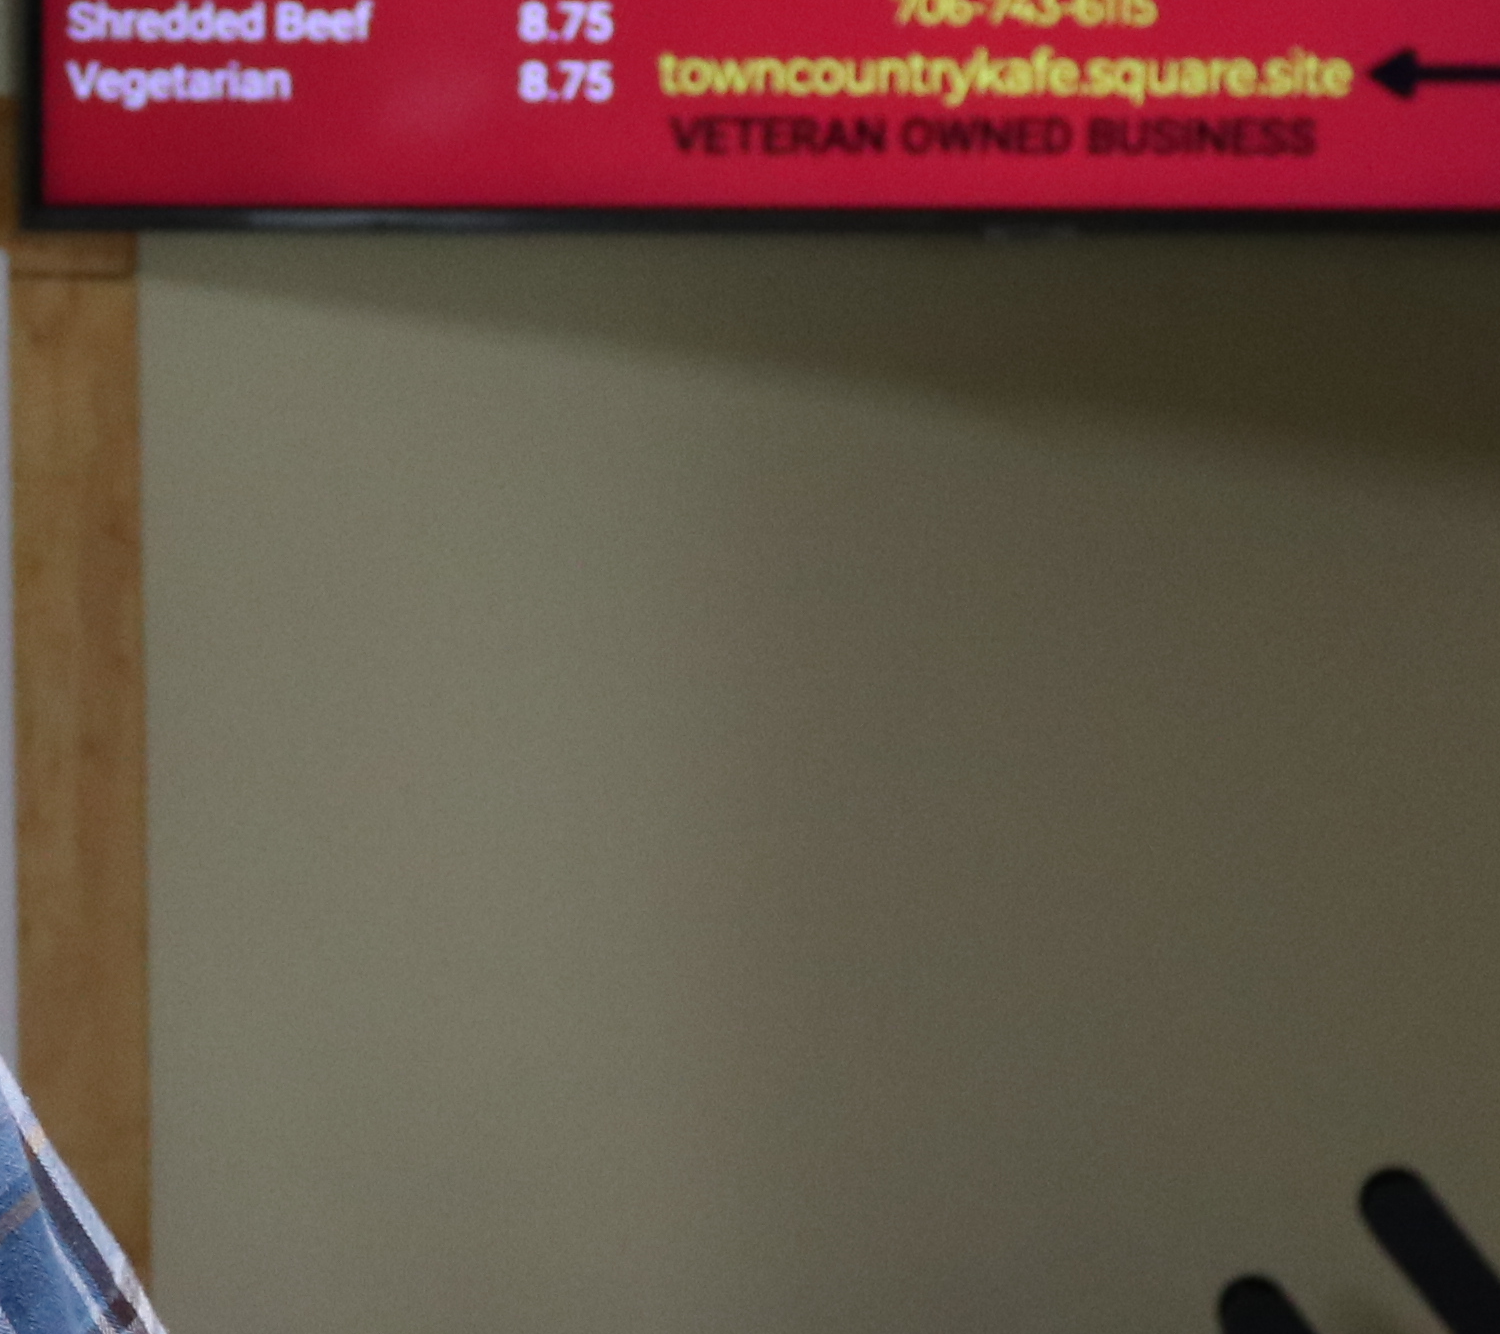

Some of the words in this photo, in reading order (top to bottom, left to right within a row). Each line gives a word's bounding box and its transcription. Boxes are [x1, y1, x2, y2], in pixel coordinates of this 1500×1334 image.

[66, 0, 267, 42] Shredded
[275, 0, 375, 42] Beef
[518, 0, 614, 43] 8.75
[65, 59, 292, 111] Vegetarian
[518, 60, 614, 103] 8.75
[656, 45, 1354, 107] towncountrykafe.square.site
[670, 115, 887, 157] VETERAN
[900, 115, 1074, 157] OWNED
[1086, 116, 1317, 157] BUSINESS
